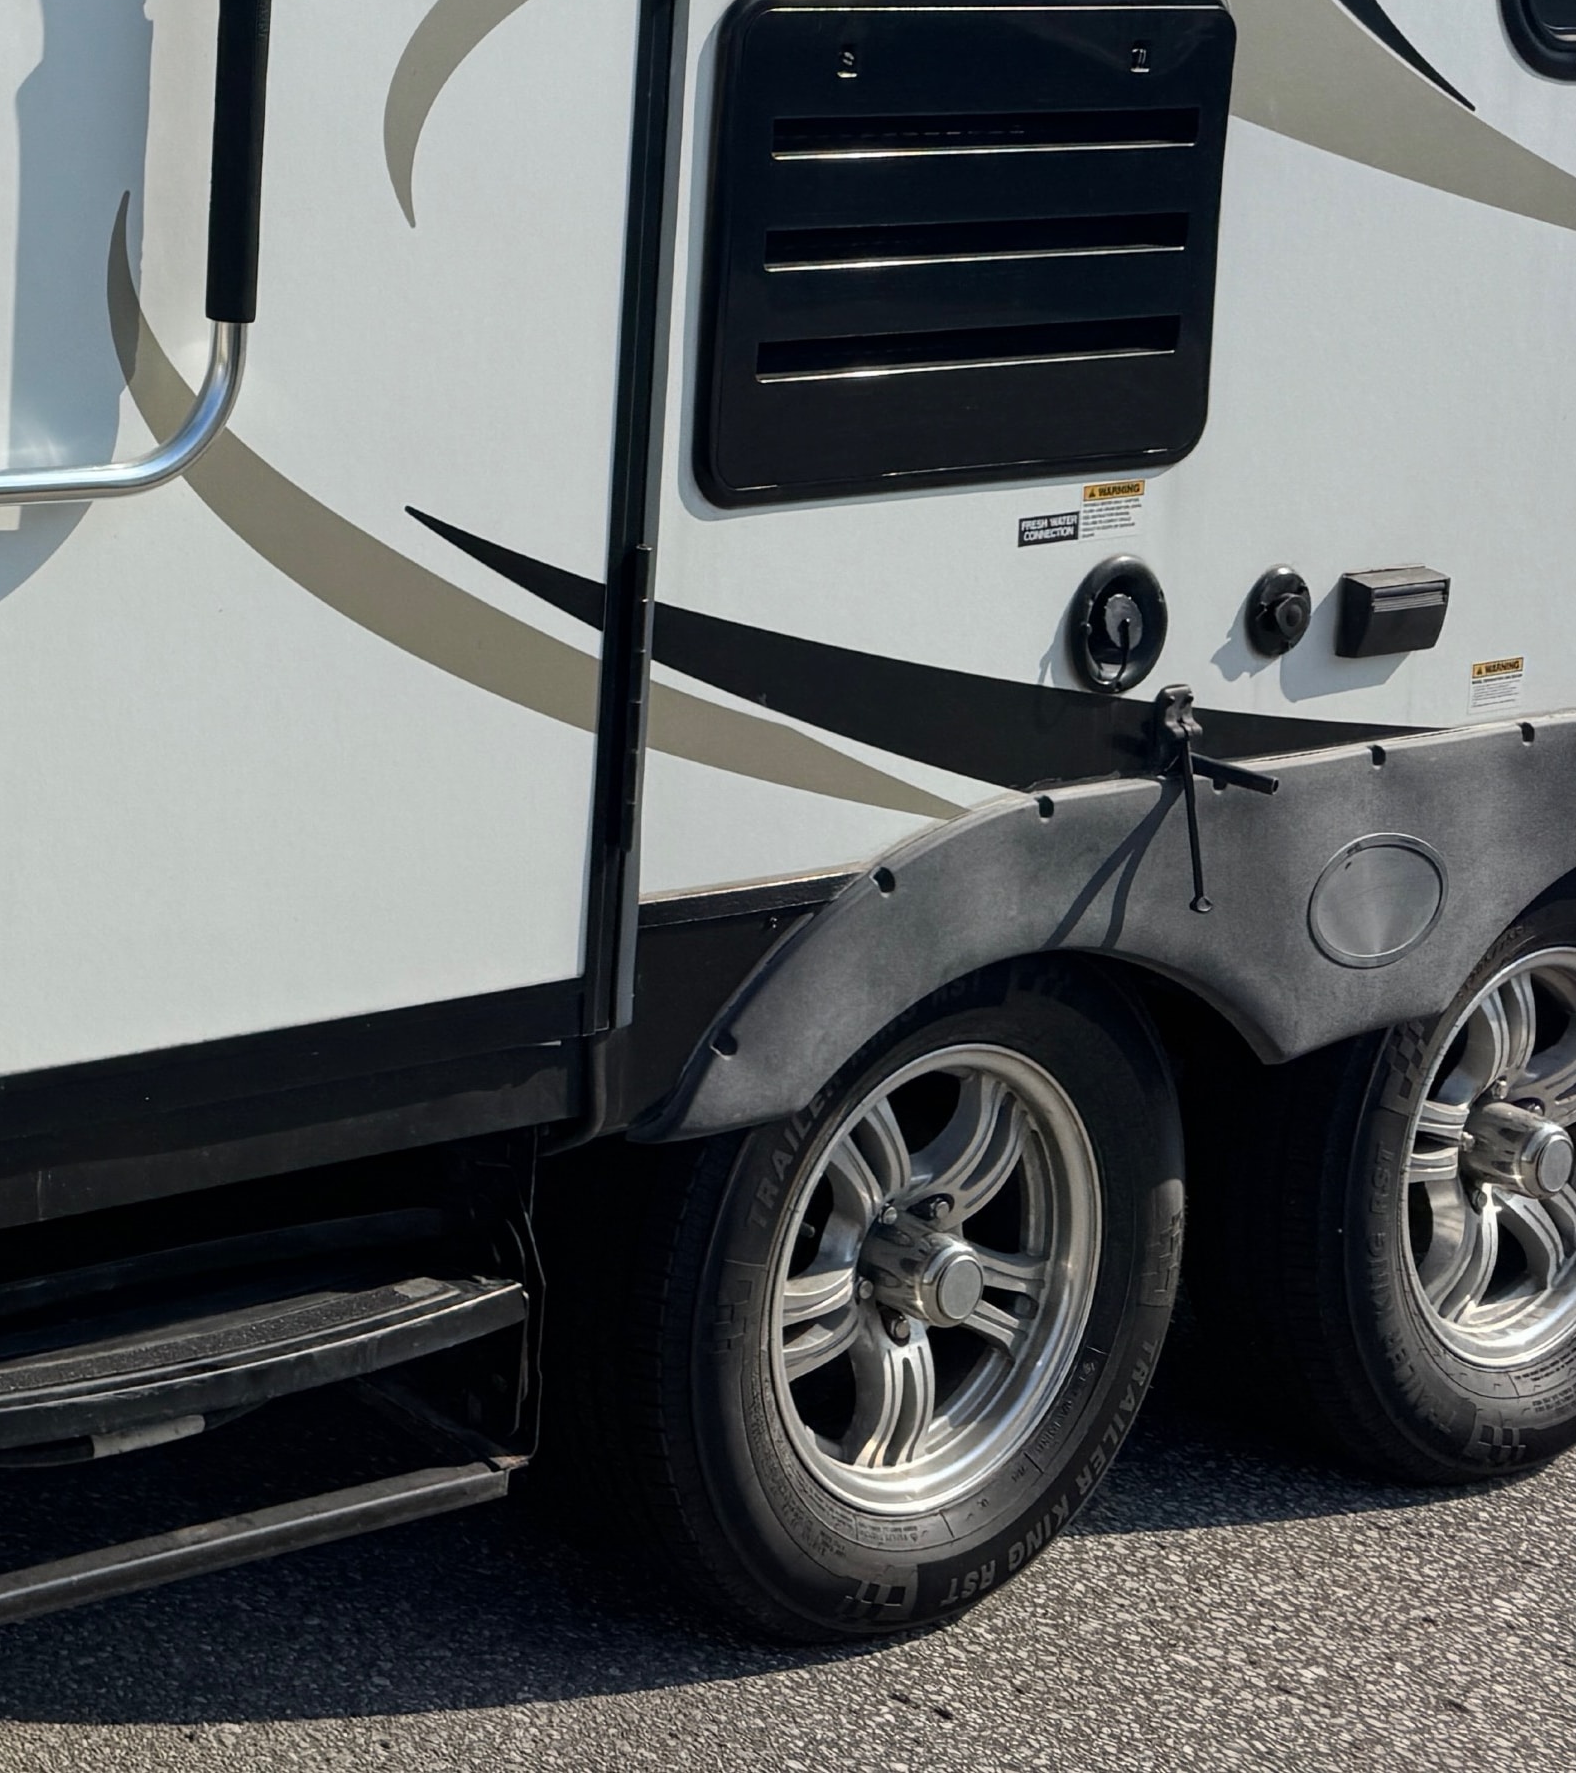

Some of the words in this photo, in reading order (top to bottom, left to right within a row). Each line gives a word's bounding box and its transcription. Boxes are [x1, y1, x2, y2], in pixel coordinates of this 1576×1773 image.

[1098, 483, 1140, 497] WARNING
[1021, 519, 1048, 531] FRESH
[1049, 514, 1077, 527] WATER
[1023, 526, 1075, 541] CONNECTION
[1075, 1338, 1160, 1495] TRAILER
[1007, 1493, 1072, 1572] KING
[941, 1559, 998, 1608] RST
